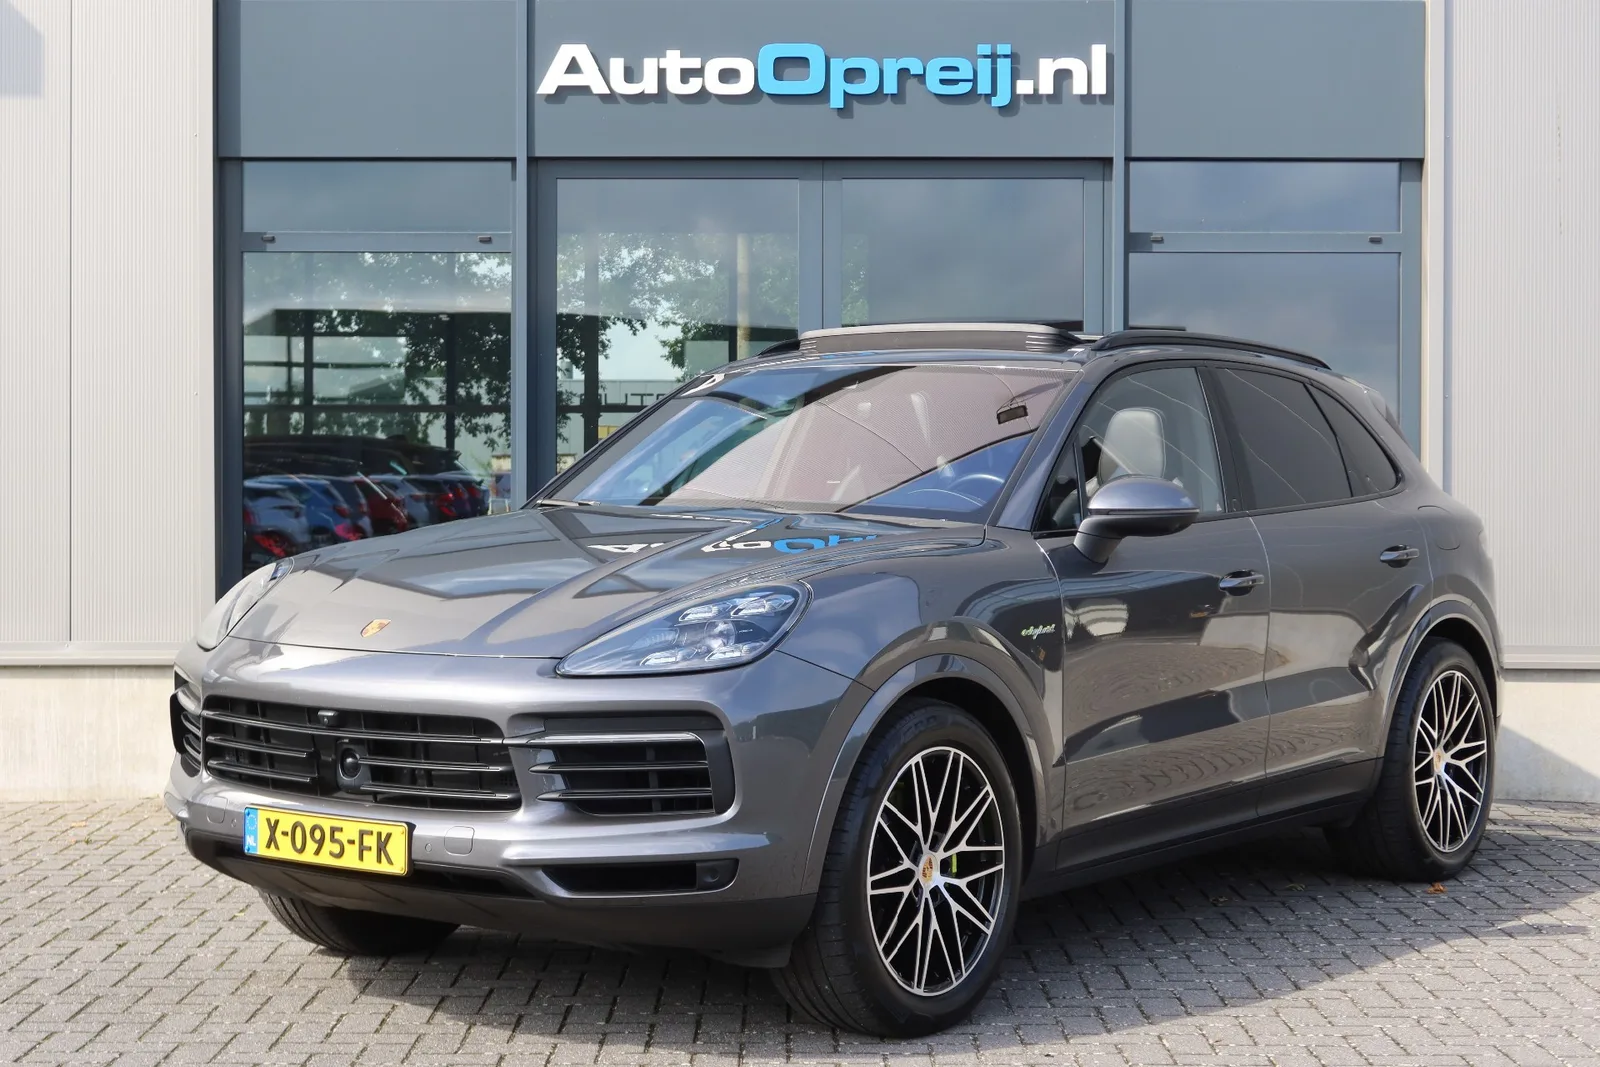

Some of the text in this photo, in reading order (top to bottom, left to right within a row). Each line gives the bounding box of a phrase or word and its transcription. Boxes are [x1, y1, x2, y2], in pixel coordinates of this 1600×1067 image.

[537, 43, 1107, 109] AutoOpreij.nl
[246, 834, 257, 847] NL
[265, 817, 394, 866] X-095-FK
